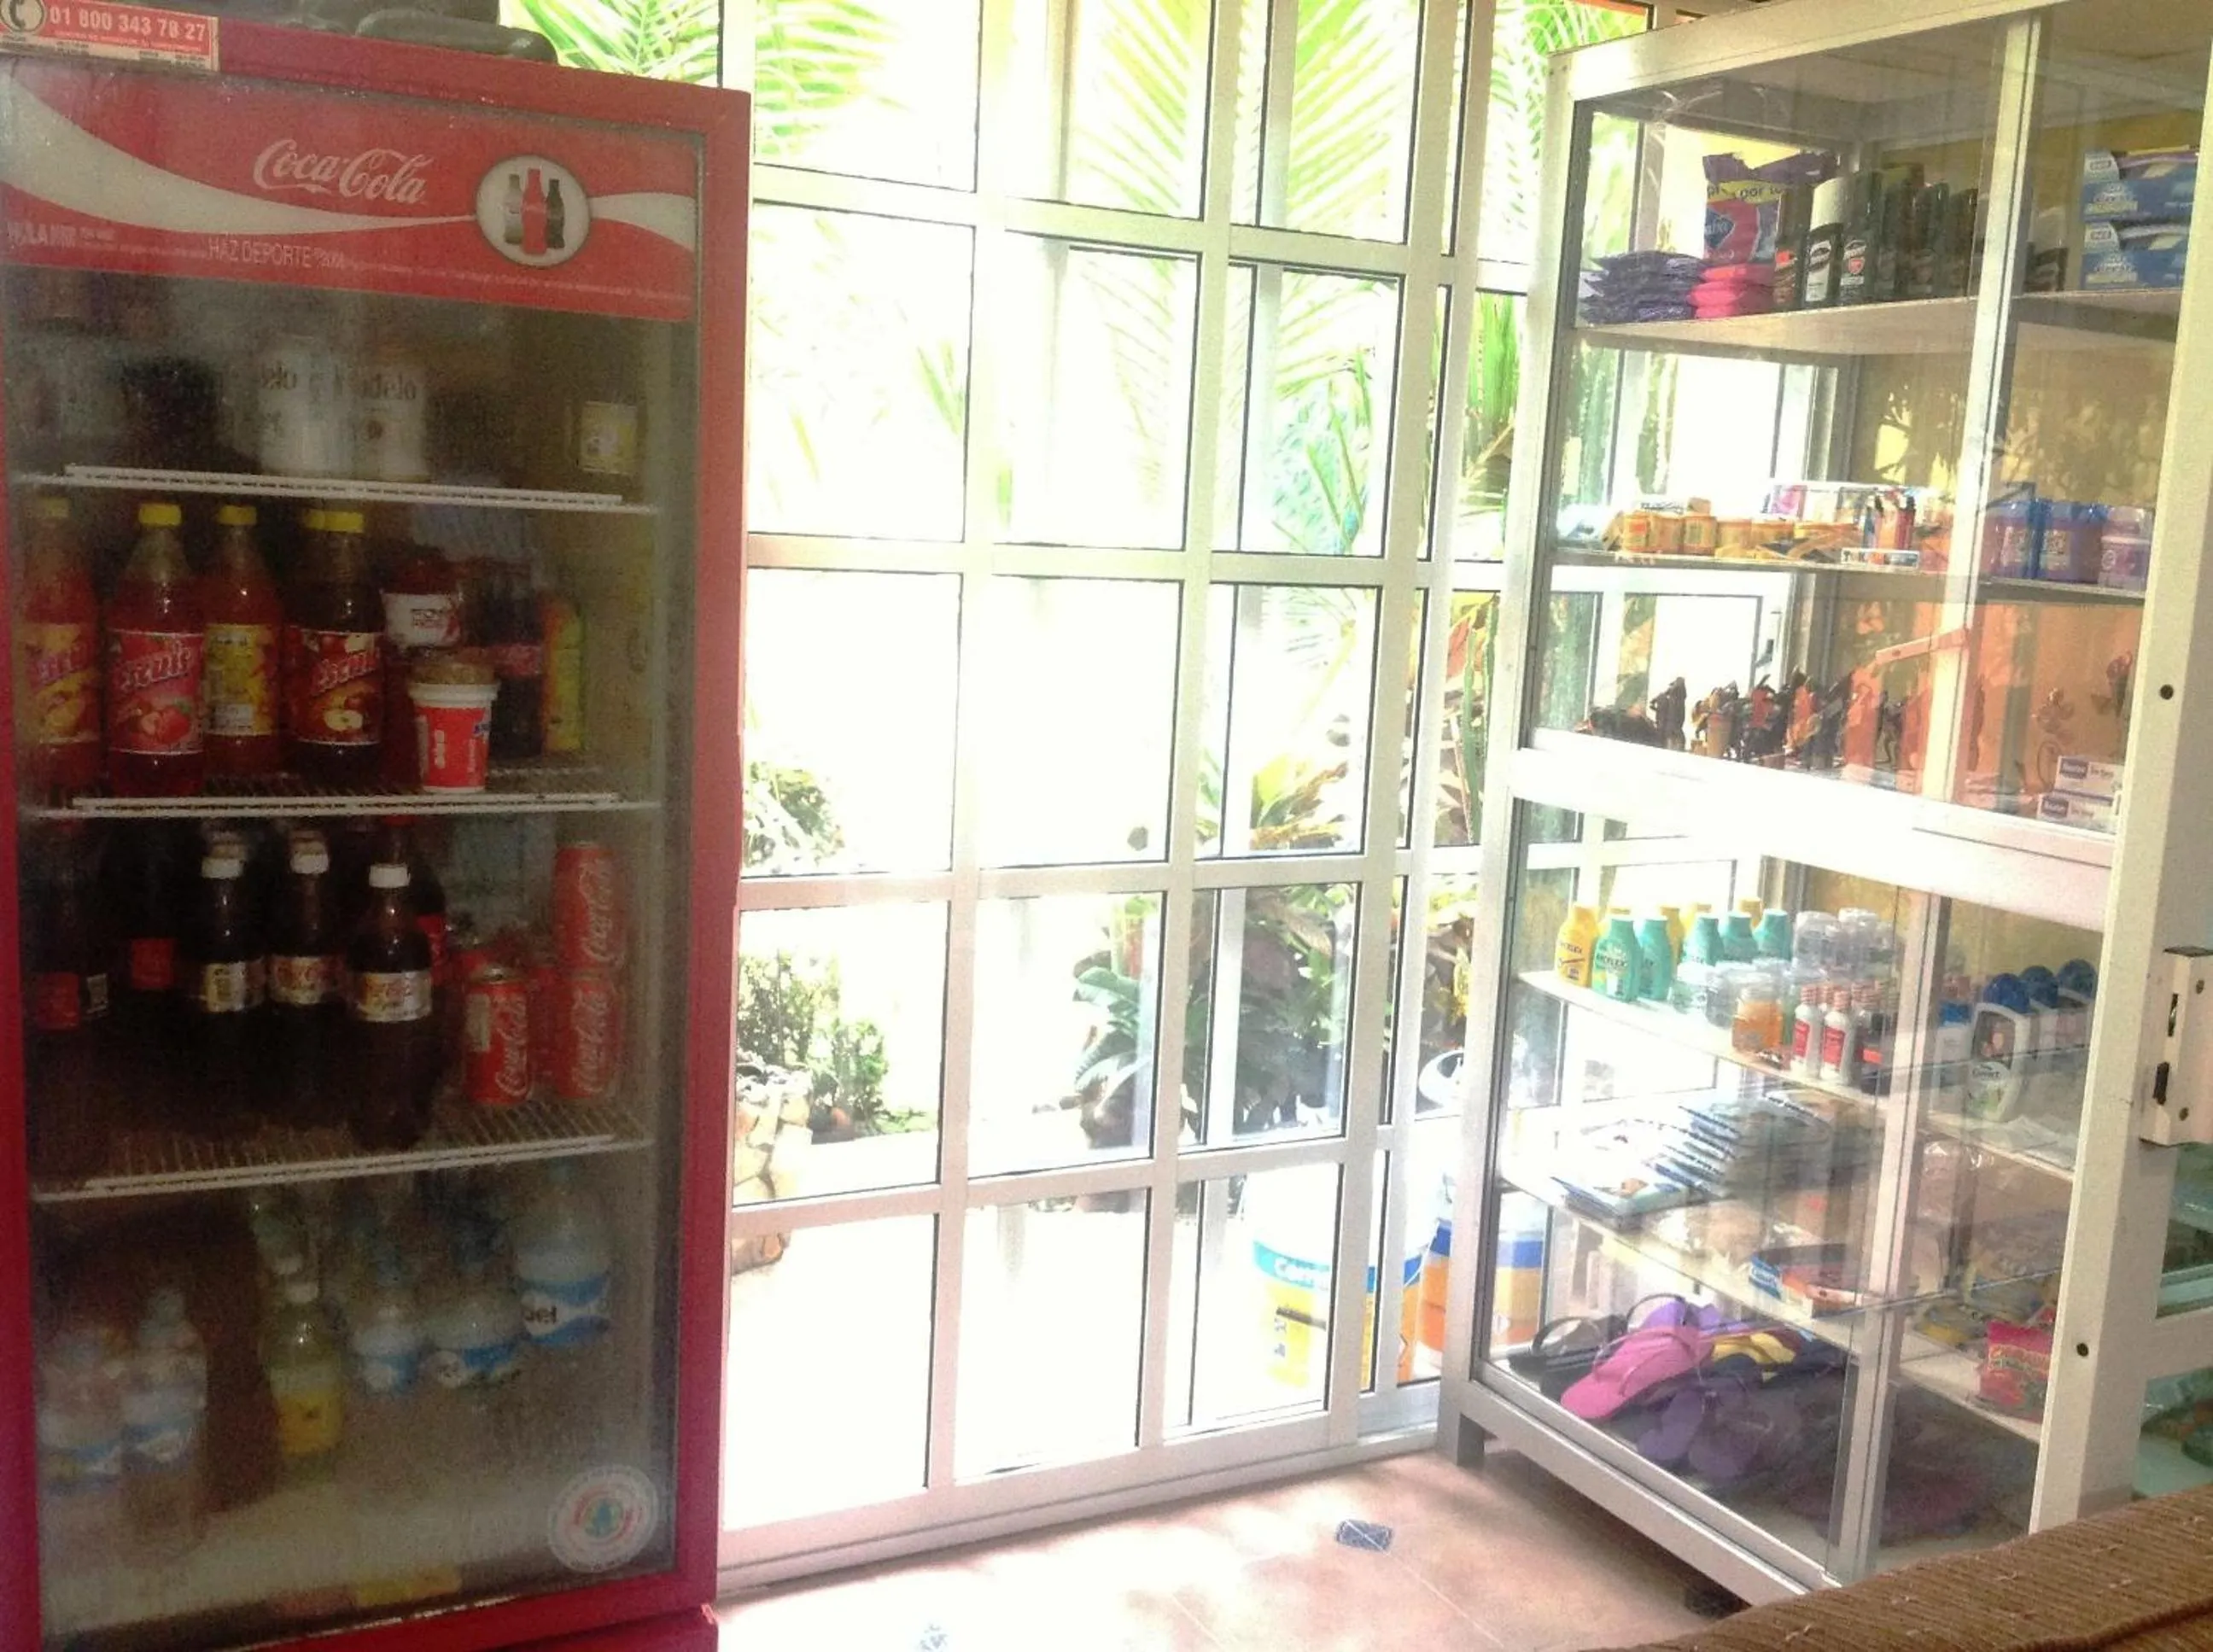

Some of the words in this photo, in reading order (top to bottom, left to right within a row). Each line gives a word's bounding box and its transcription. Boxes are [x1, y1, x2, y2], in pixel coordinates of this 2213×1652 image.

[49, 7, 70, 25] 01
[79, 10, 113, 31] 800
[118, 14, 152, 36] 343
[184, 23, 206, 42] 27
[242, 240, 312, 268] DEPORTE
